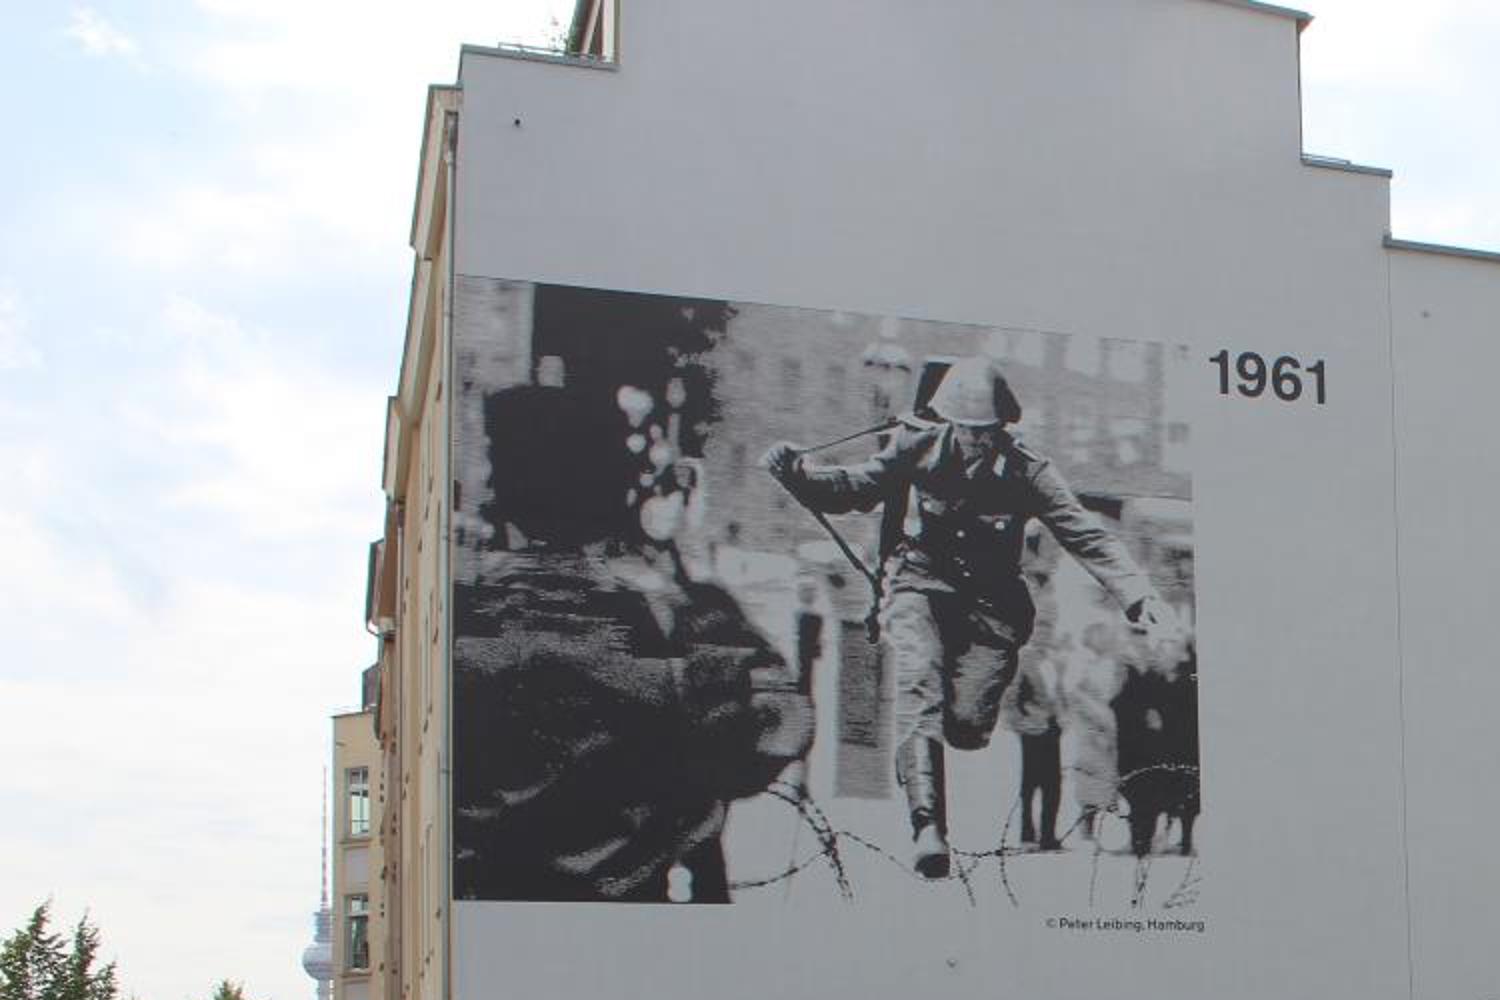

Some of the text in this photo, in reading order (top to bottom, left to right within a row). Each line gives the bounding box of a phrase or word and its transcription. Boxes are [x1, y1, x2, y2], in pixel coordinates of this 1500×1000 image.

[1209, 349, 1326, 405] 1961
[1059, 917, 1093, 930] Peter
[1097, 918, 1145, 933] Leibing,
[1148, 918, 1205, 933] Hamburg
